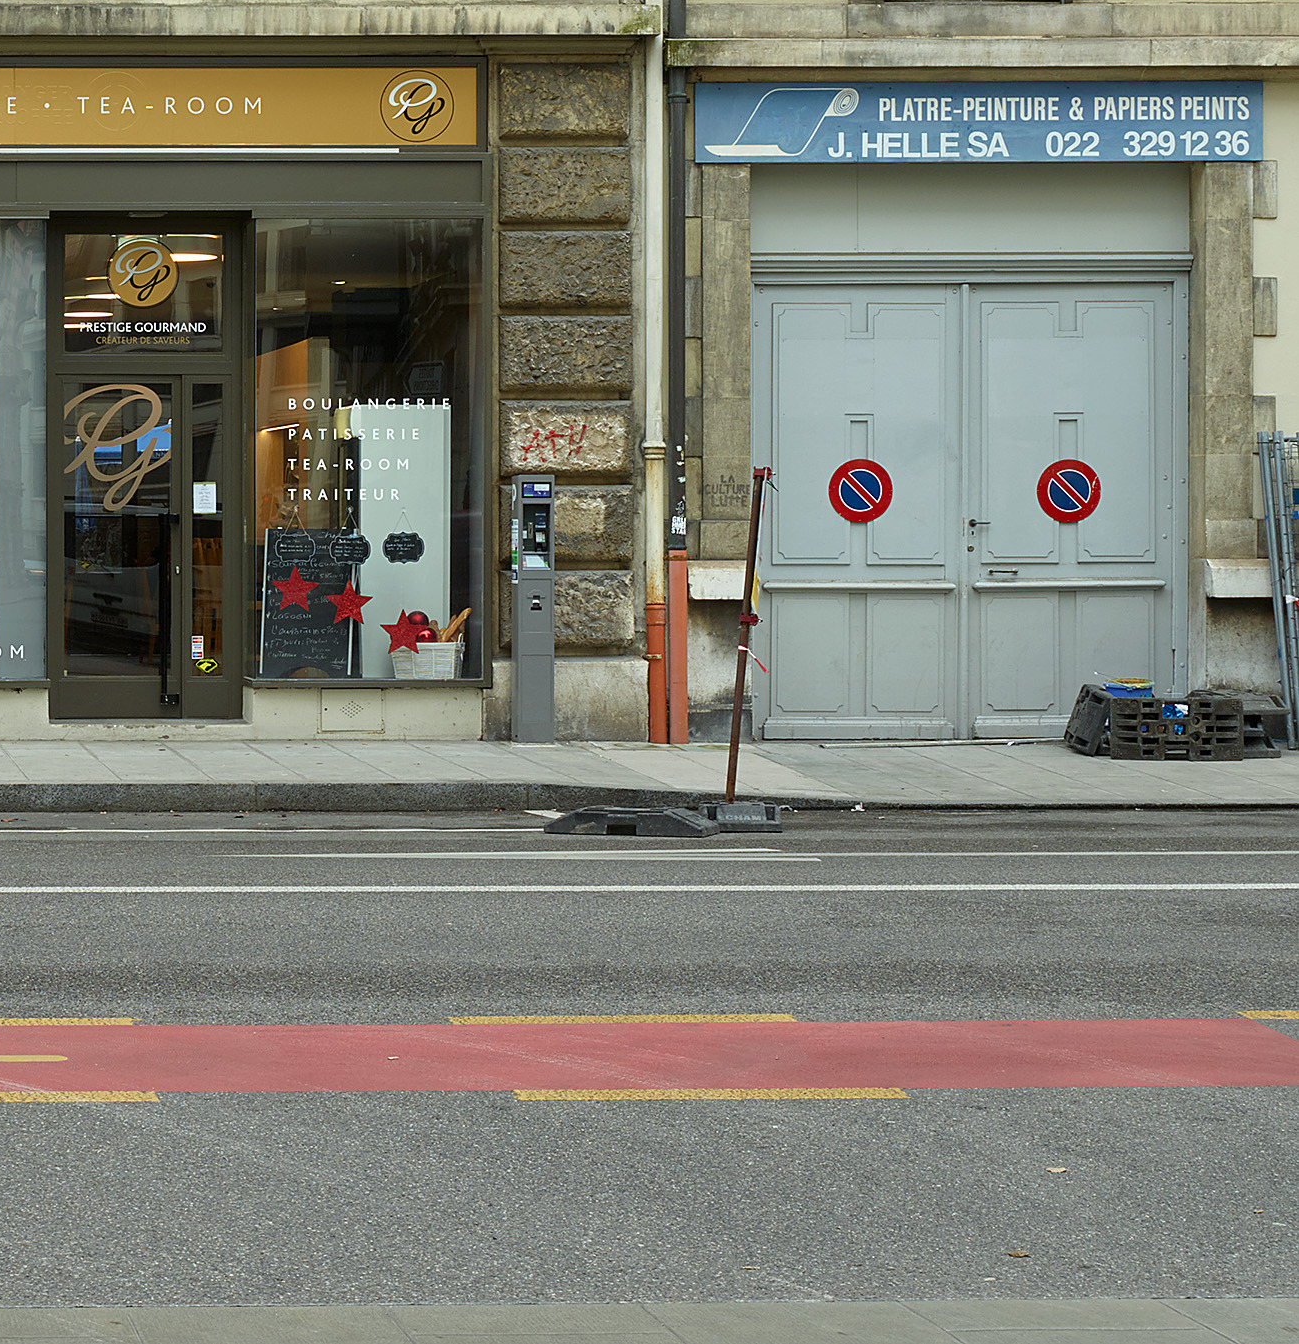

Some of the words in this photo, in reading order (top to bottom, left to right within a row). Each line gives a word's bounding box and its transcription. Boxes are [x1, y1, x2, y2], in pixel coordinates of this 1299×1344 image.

[77, 96, 263, 114] TEA-ROOM
[879, 97, 1059, 122] PLATRE-PEINTURE
[1068, 97, 1084, 121] &
[1093, 97, 1174, 121] PAPIERS
[1181, 96, 1250, 121] PEINTS
[828, 132, 853, 159] J.
[861, 131, 958, 159] HELLE
[967, 131, 1010, 158] SA
[1045, 131, 1101, 158] 022
[79, 322, 132, 333] PRESTIGE
[134, 322, 207, 333] GOURMAND
[95, 335, 138, 345] CRÉATEUR
[139, 337, 151, 345] DE
[153, 337, 191, 345] SAVEURS
[288, 398, 451, 410] BOULANGERIE
[288, 428, 420, 440] PATISSERIE
[288, 458, 409, 470] TEA-ROOM
[288, 488, 400, 500] TRAITEUR
[704, 484, 751, 495] CULTURE
